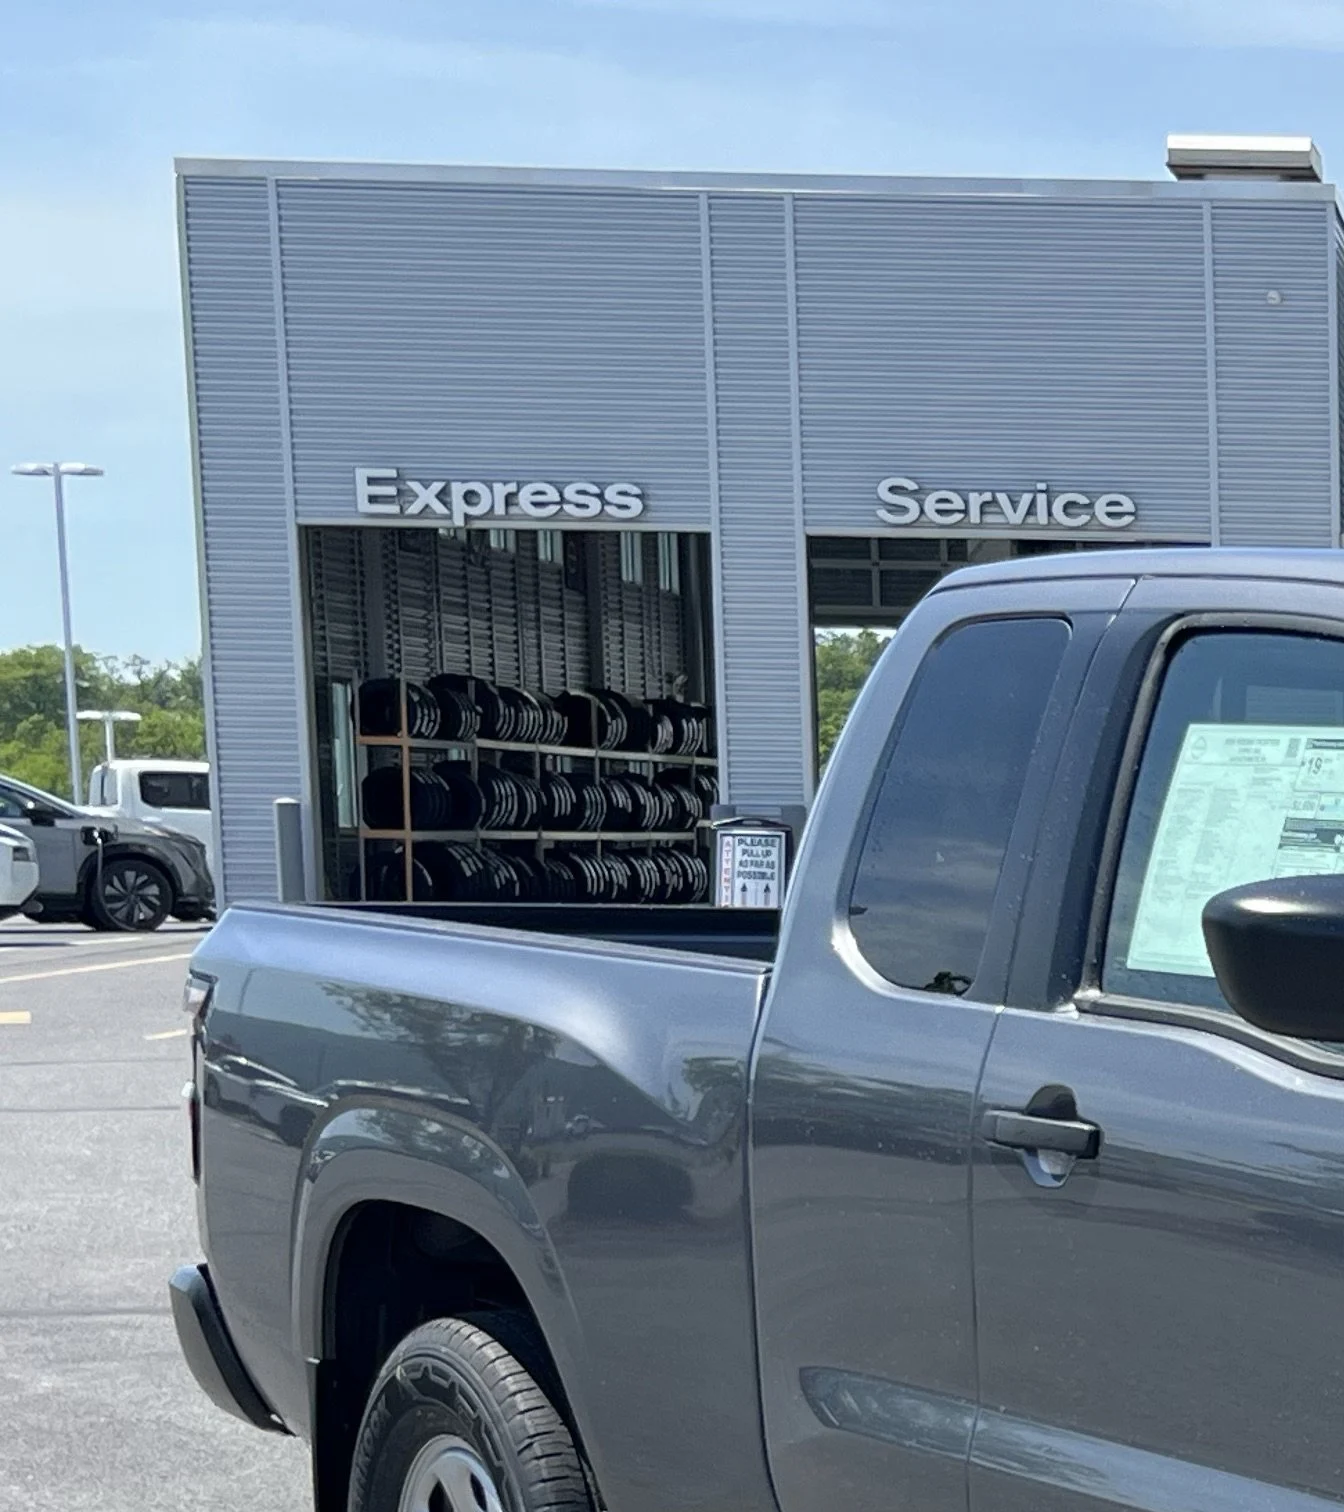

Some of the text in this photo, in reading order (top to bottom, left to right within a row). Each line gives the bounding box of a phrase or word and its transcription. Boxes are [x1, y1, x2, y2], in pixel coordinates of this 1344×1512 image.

[355, 467, 644, 527] Express
[875, 476, 1137, 528] Service
[737, 838, 777, 848] PLEASE
